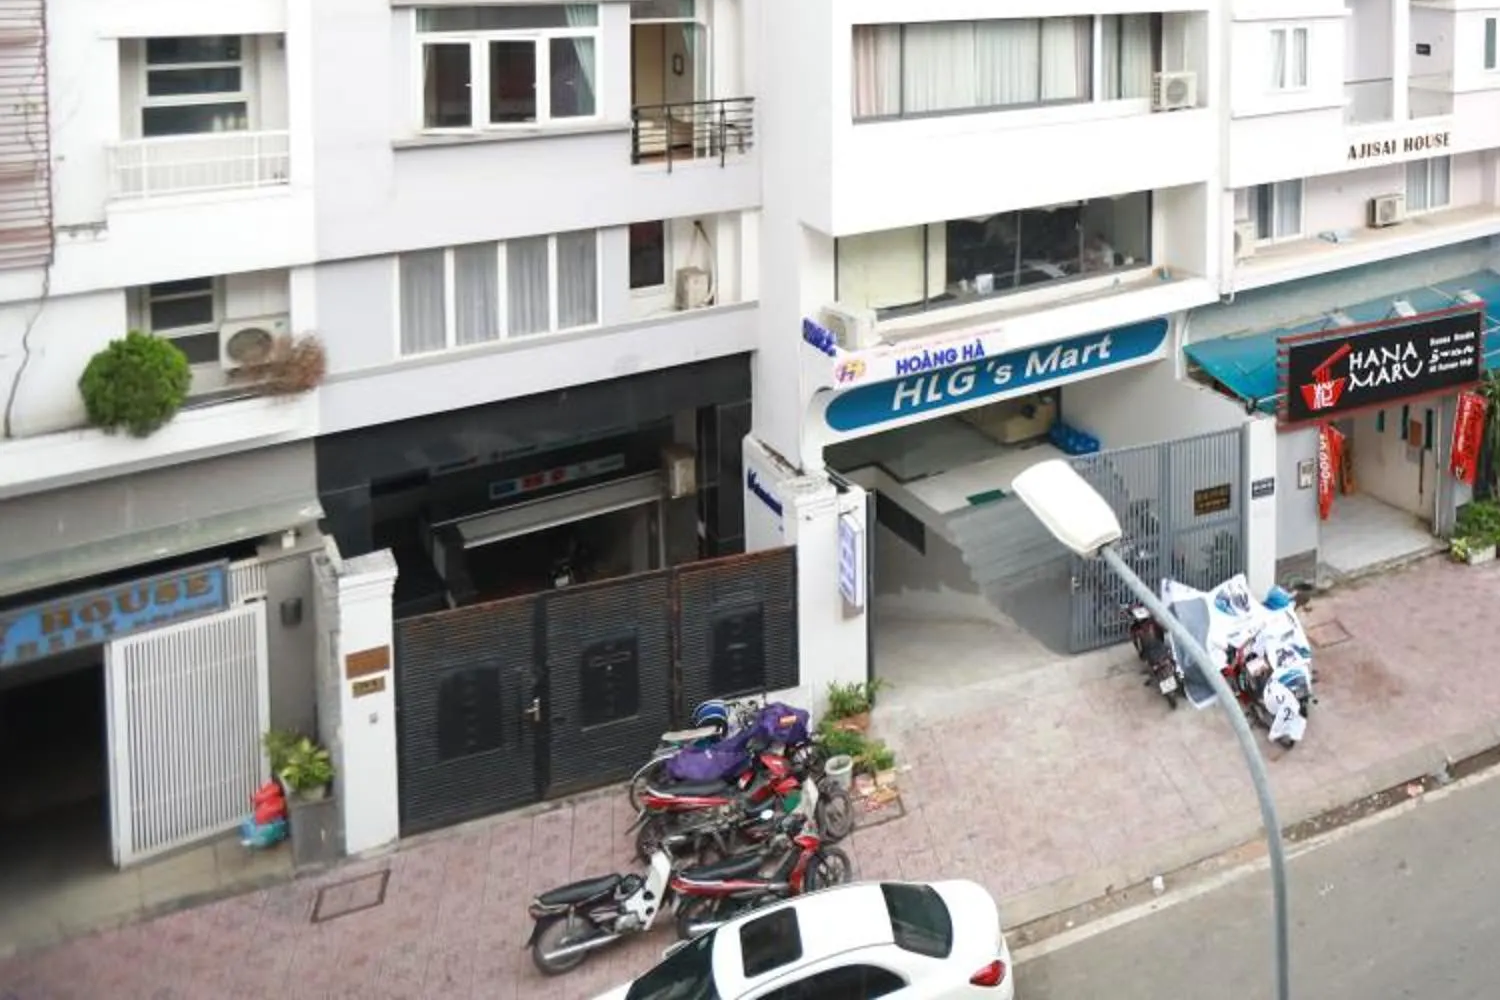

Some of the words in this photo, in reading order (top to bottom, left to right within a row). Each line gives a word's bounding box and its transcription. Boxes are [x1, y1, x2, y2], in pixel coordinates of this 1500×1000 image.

[1348, 140, 1396, 160] AJISAI
[1403, 132, 1450, 152] HOUSE
[896, 349, 958, 375] HOÀNG
[962, 338, 985, 360] HÀ
[1025, 335, 1113, 378] Mart
[1349, 341, 1418, 371] HANA
[1348, 359, 1423, 392] MARU
[41, 573, 213, 635] HOUSE
